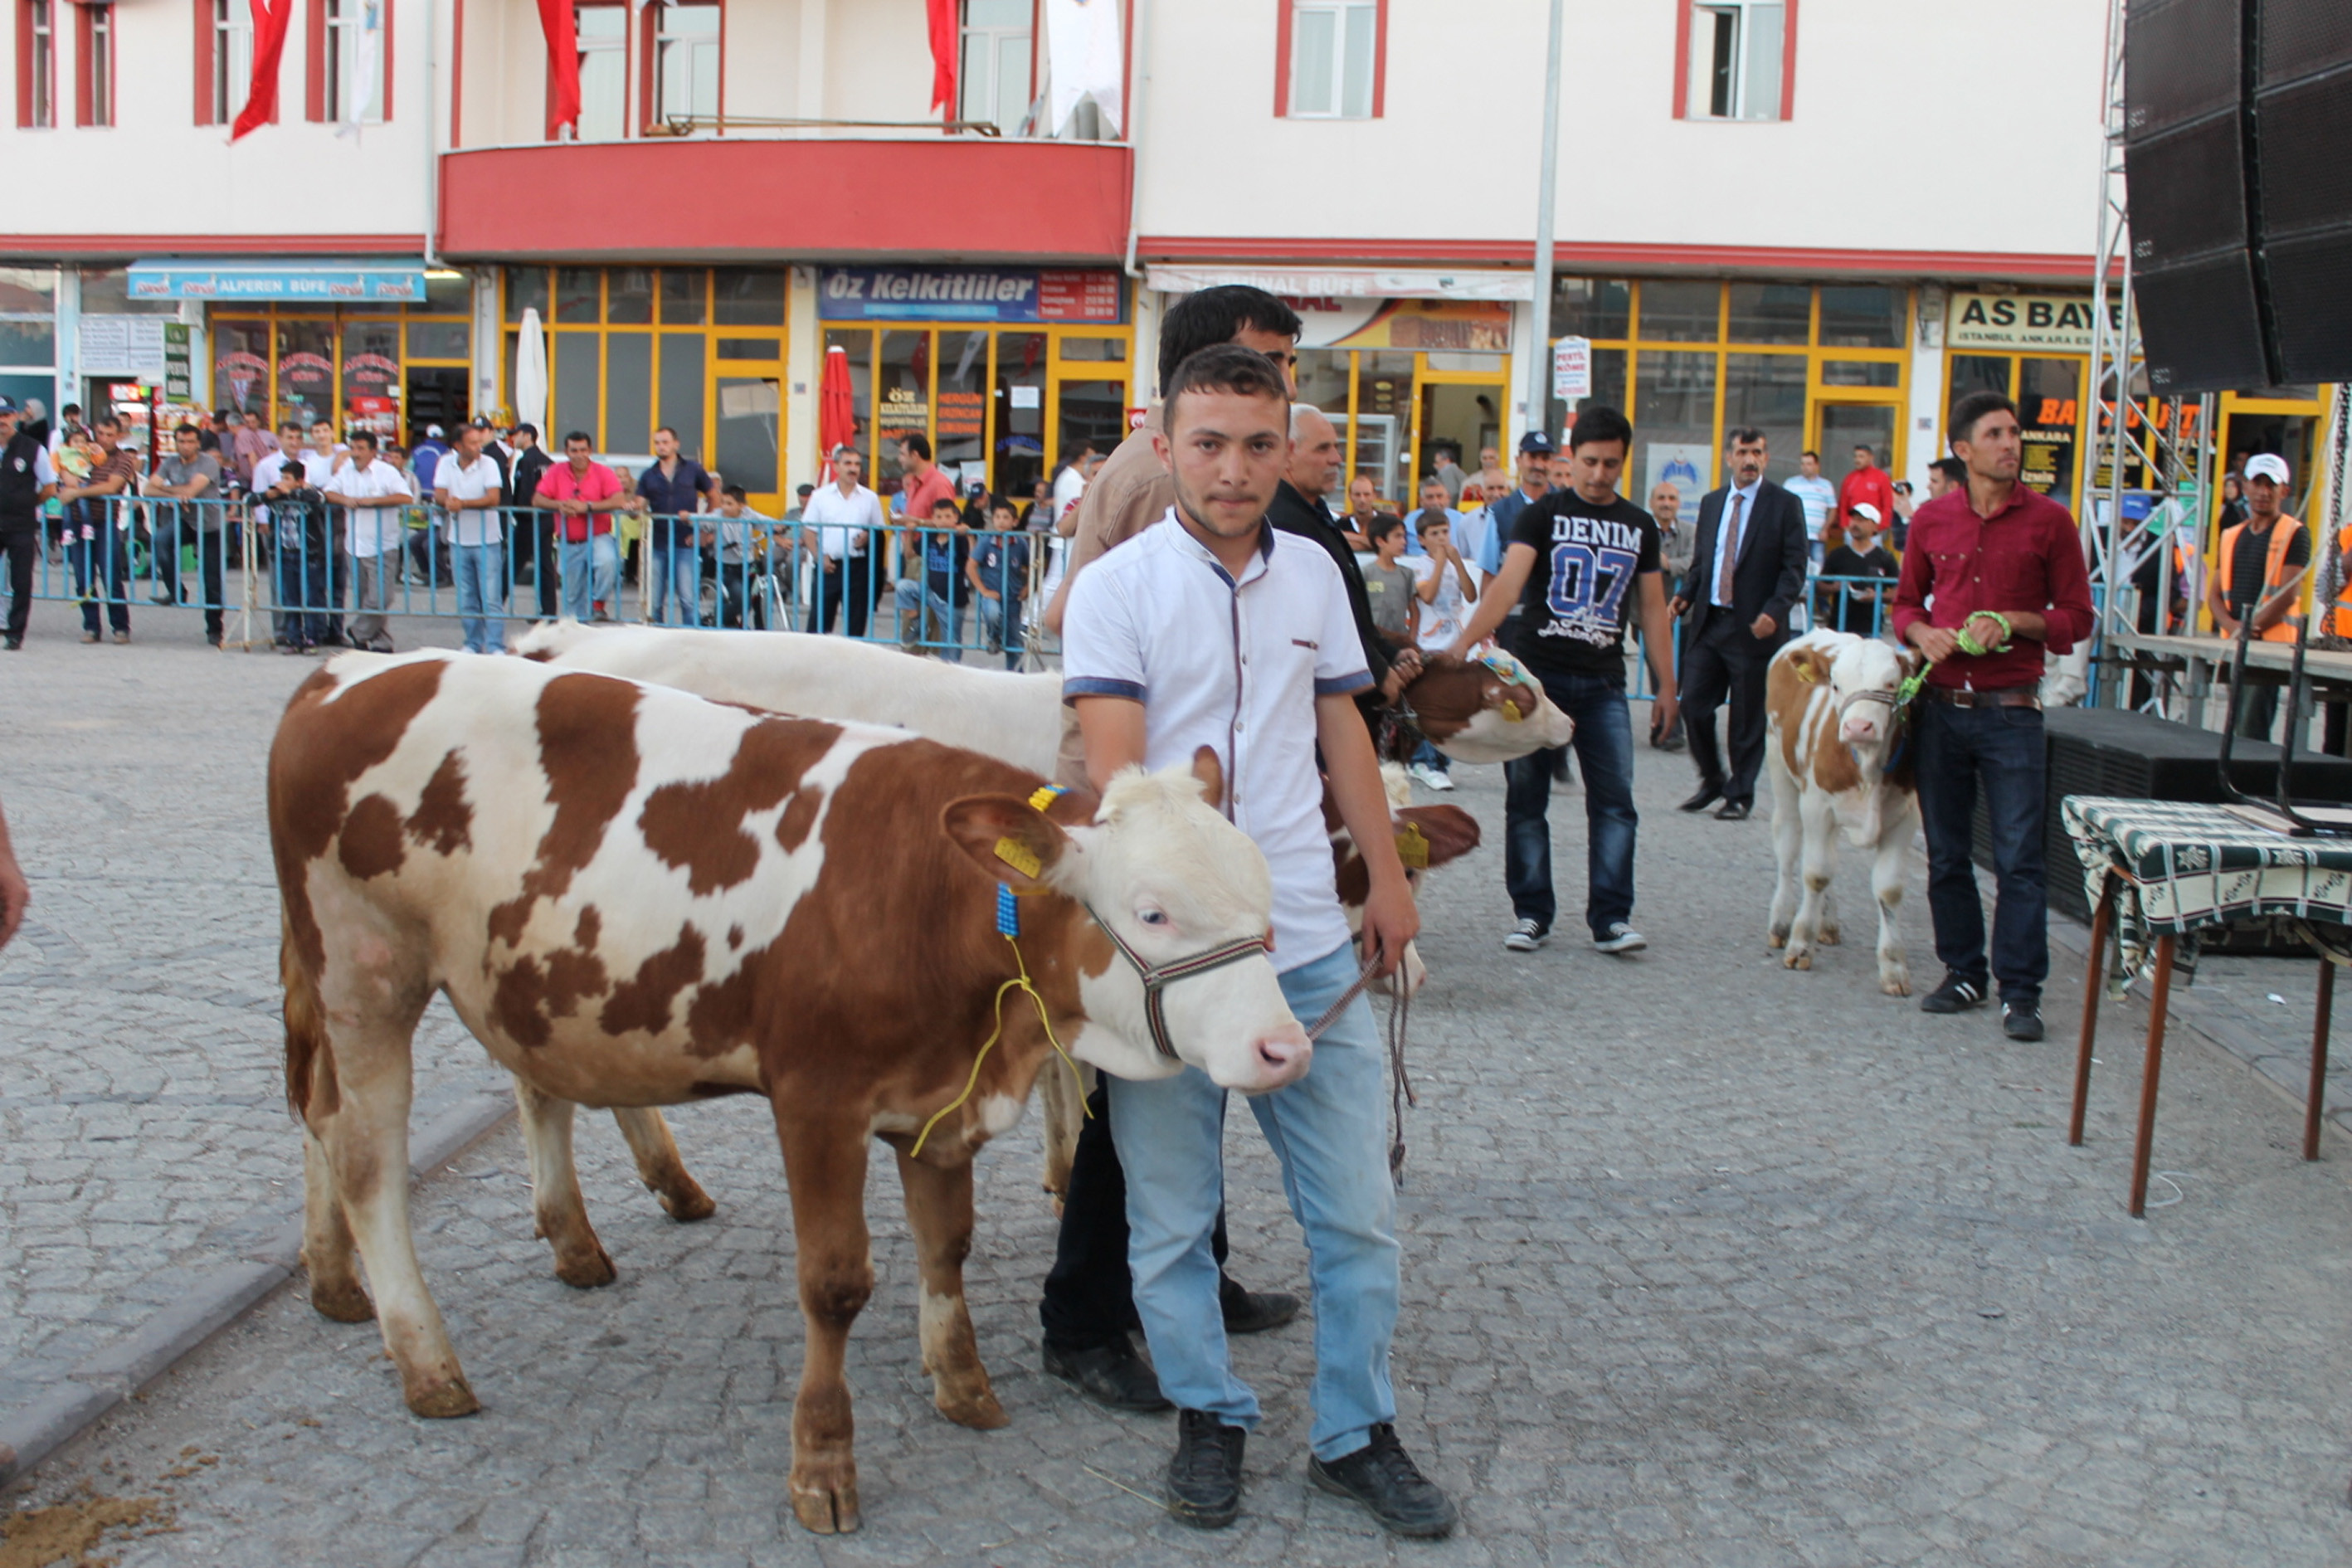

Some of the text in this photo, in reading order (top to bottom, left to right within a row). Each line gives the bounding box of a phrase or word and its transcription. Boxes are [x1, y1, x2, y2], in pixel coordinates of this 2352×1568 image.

[220, 278, 328, 293] ALPEREN BÜFE
[828, 269, 1034, 301] Öz Kelkitliler
[1307, 274, 1366, 296] BÜFE
[1960, 299, 2016, 326] AS
[2019, 335, 2072, 345] ANKARA
[2021, 430, 2072, 443] ANKARA
[1551, 514, 1643, 554] DENIM
[1546, 542, 1639, 628] 07
